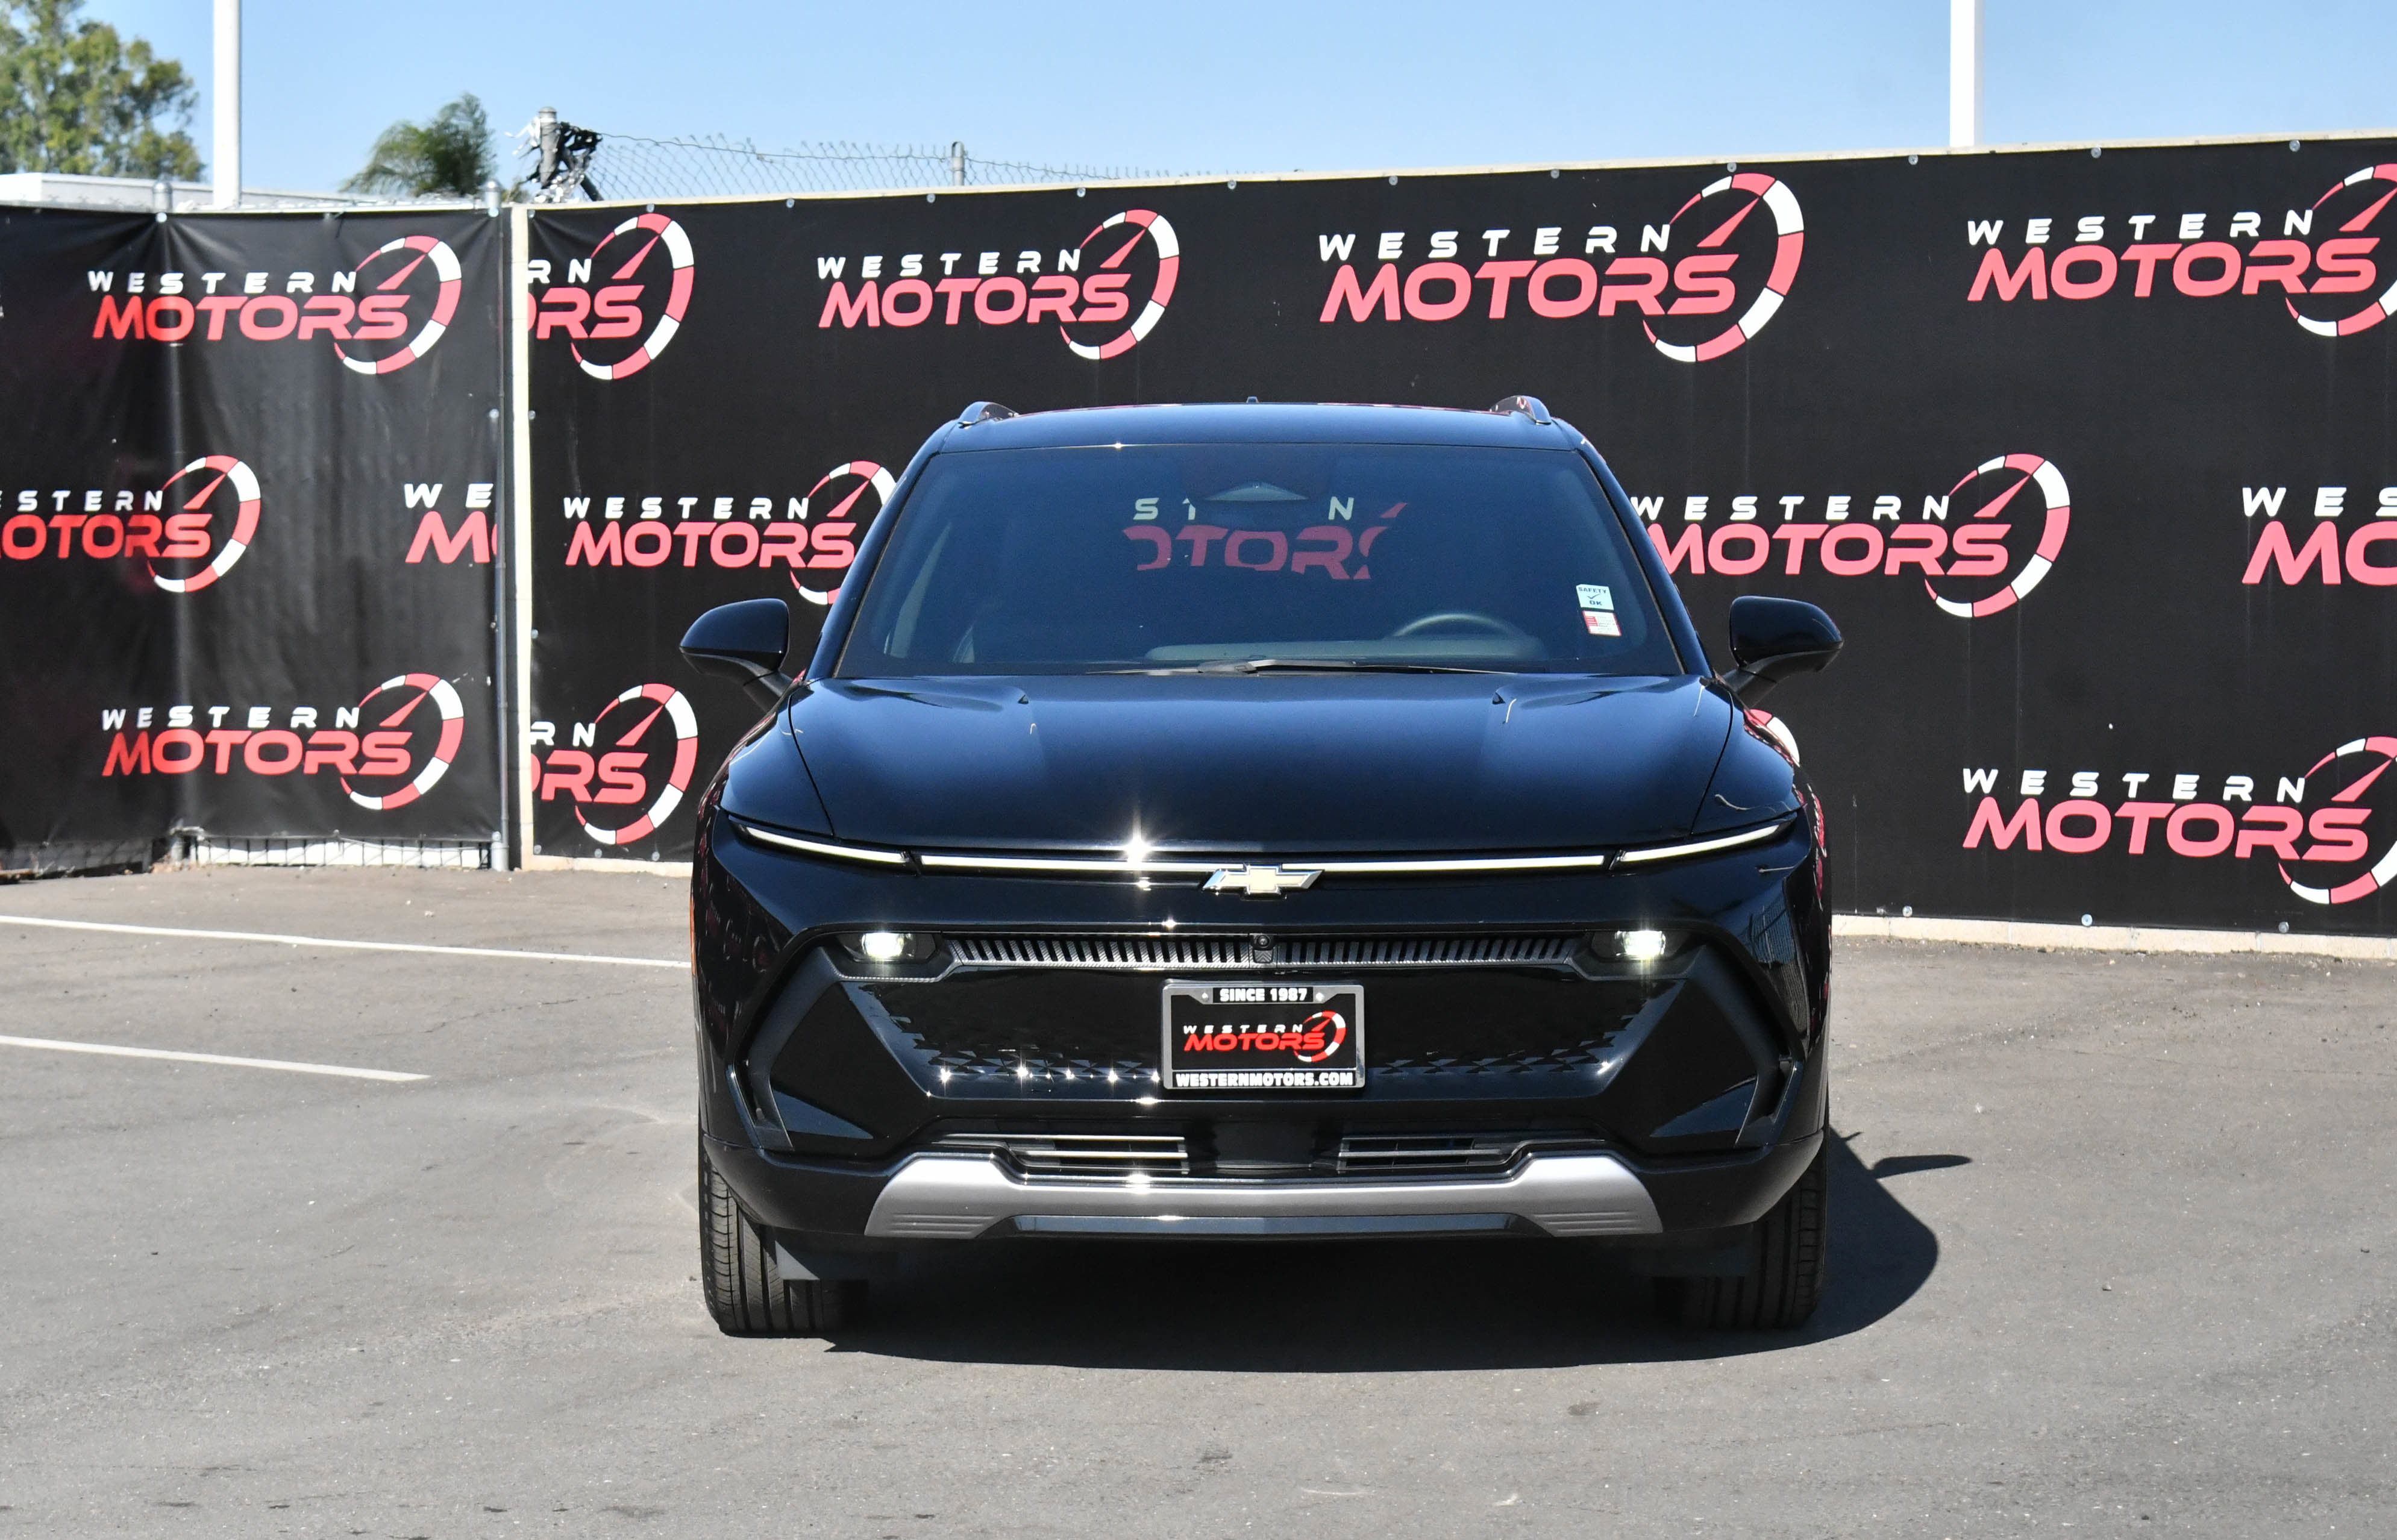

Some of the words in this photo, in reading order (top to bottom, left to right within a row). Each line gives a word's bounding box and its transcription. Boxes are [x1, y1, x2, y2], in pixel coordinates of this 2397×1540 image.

[1319, 224, 1670, 260] WESTERN
[1968, 210, 2313, 245] WESTERN
[818, 248, 1080, 279] WESTERN
[1967, 238, 2380, 301] MOTORS
[88, 271, 357, 293] WESTERN
[1320, 254, 1738, 322] MOTORS
[92, 294, 410, 342] MOTORS
[528, 285, 645, 339] RS
[818, 274, 1131, 328] MOTORS
[0, 490, 163, 512] STERN
[404, 483, 494, 509] WE
[564, 497, 809, 519] WESTERN
[1630, 496, 1949, 521] WESTERN
[0, 513, 212, 560] OTORS
[405, 510, 498, 564] M
[565, 521, 857, 568] MOTORS
[1647, 522, 2012, 576] MOTORS
[102, 706, 360, 731] WESTERN
[102, 730, 413, 776] MOTORS
[1963, 768, 2305, 803] WESTERN
[1963, 796, 2372, 862] MOTORS
[1220, 988, 1265, 1001] SINCE
[1270, 988, 1308, 1001] 1987
[1183, 1024, 1303, 1034] WESTERN
[1184, 1033, 1326, 1051] MOTORS
[1176, 1072, 1353, 1086] WESTERNMOTORS.COM
